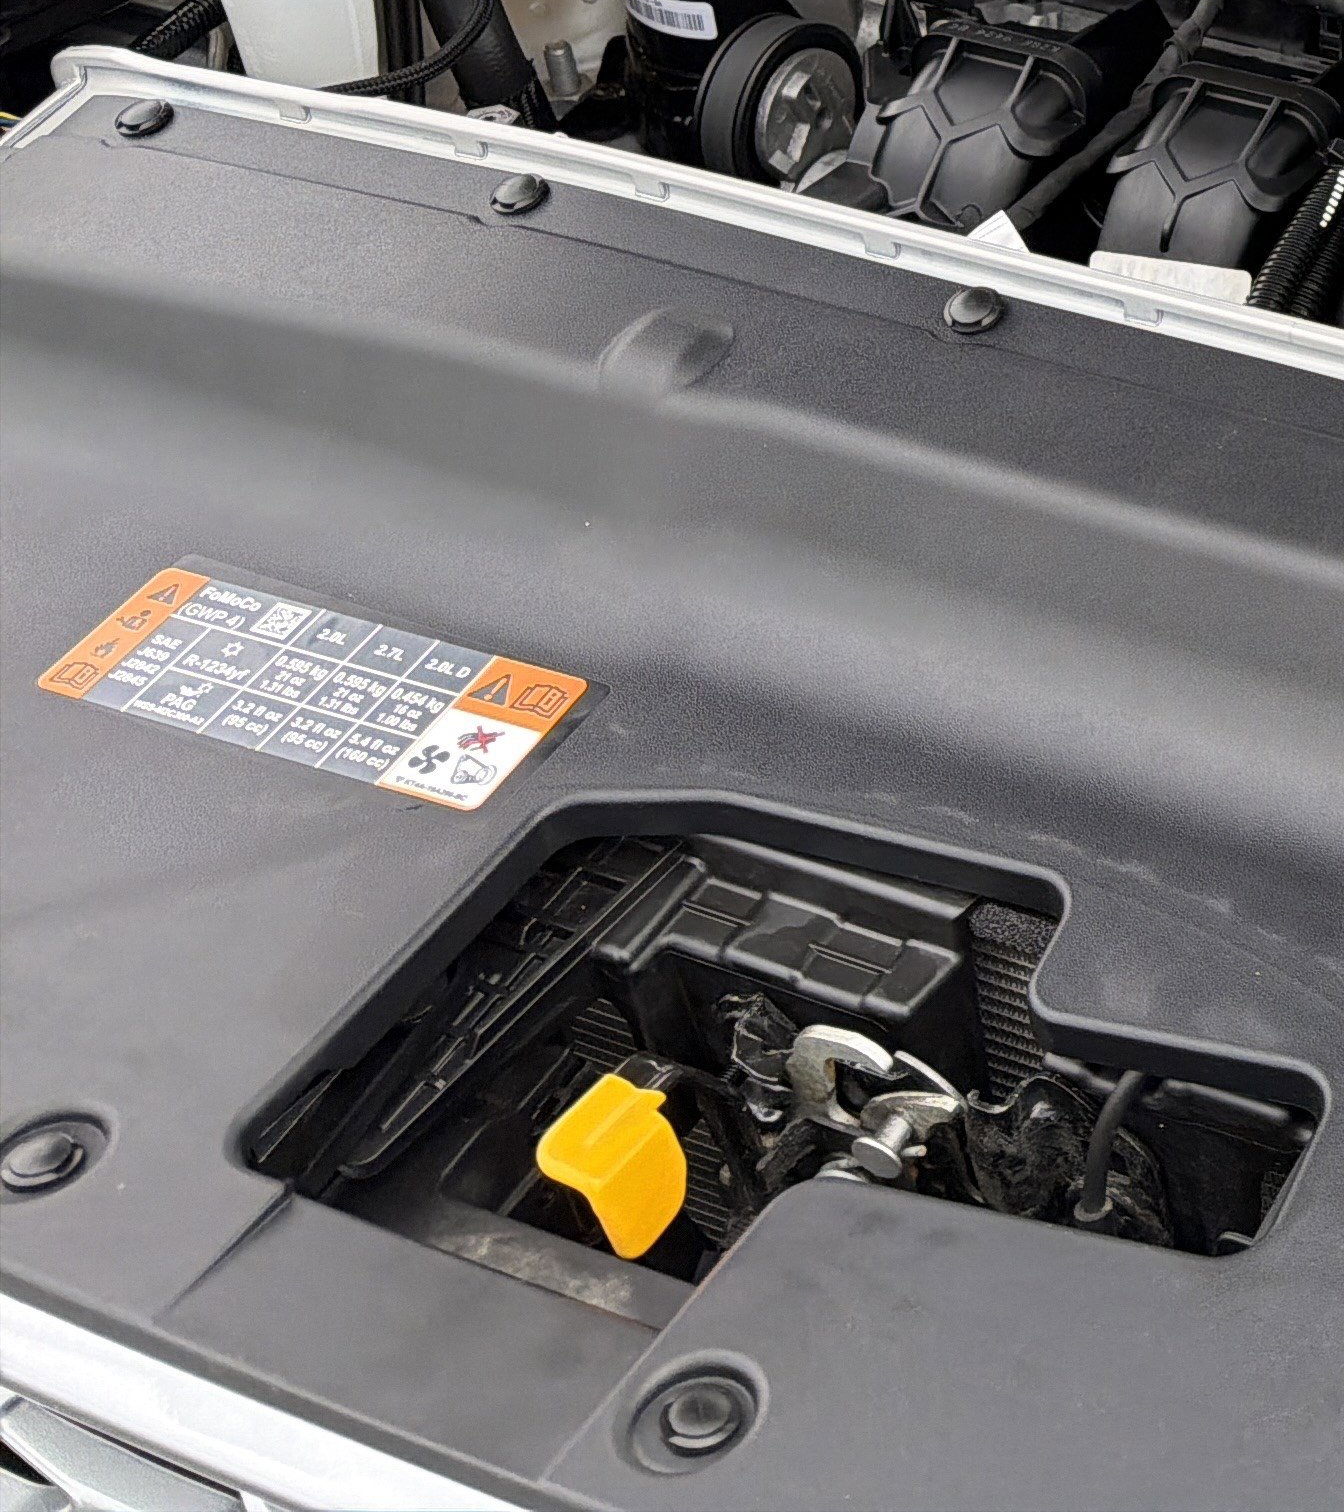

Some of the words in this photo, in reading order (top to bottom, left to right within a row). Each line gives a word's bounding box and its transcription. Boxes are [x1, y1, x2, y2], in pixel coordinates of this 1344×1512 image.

[199, 587, 262, 612] FoMoCo
[178, 602, 227, 622] (GWP
[225, 613, 246, 630] 4)
[151, 635, 183, 651] SAE
[316, 628, 348, 646] 2.0L
[137, 648, 171, 662] J639
[373, 644, 404, 662] 2.7L
[182, 654, 250, 681] R-1234yf
[275, 656, 309, 675] 0.595
[309, 664, 330, 682] kg
[425, 659, 455, 676] 2.0L
[454, 666, 471, 679] D
[259, 680, 281, 693] 1.31
[281, 685, 301, 699] lbs
[276, 671, 289, 682] 21
[290, 676, 307, 687] oz
[333, 672, 368, 690] 0.595
[367, 680, 388, 699] kg
[160, 692, 198, 711] PAG
[333, 687, 347, 698] 21
[348, 692, 364, 703] oz
[391, 688, 427, 706] 0.454
[427, 696, 446, 714] kg
[231, 700, 252, 714] 3.2
[252, 704, 264, 717] fl
[263, 710, 284, 723] oz
[318, 696, 340, 710] 1.31
[340, 702, 359, 716] lbs
[394, 703, 408, 714] 16
[408, 709, 423, 720] oz
[221, 714, 245, 730] (95
[245, 720, 269, 736] cc)
[290, 716, 311, 730] 3.2
[311, 721, 323, 734] fl
[323, 728, 343, 740] oz
[376, 713, 401, 726] 1.00
[399, 718, 419, 732] lbs
[281, 731, 304, 748] (95
[304, 738, 328, 754] cc)
[349, 733, 369, 747] 5.4
[369, 738, 381, 750] fl
[381, 744, 401, 756] oz
[335, 747, 365, 764] (160
[365, 755, 390, 772] cc)
